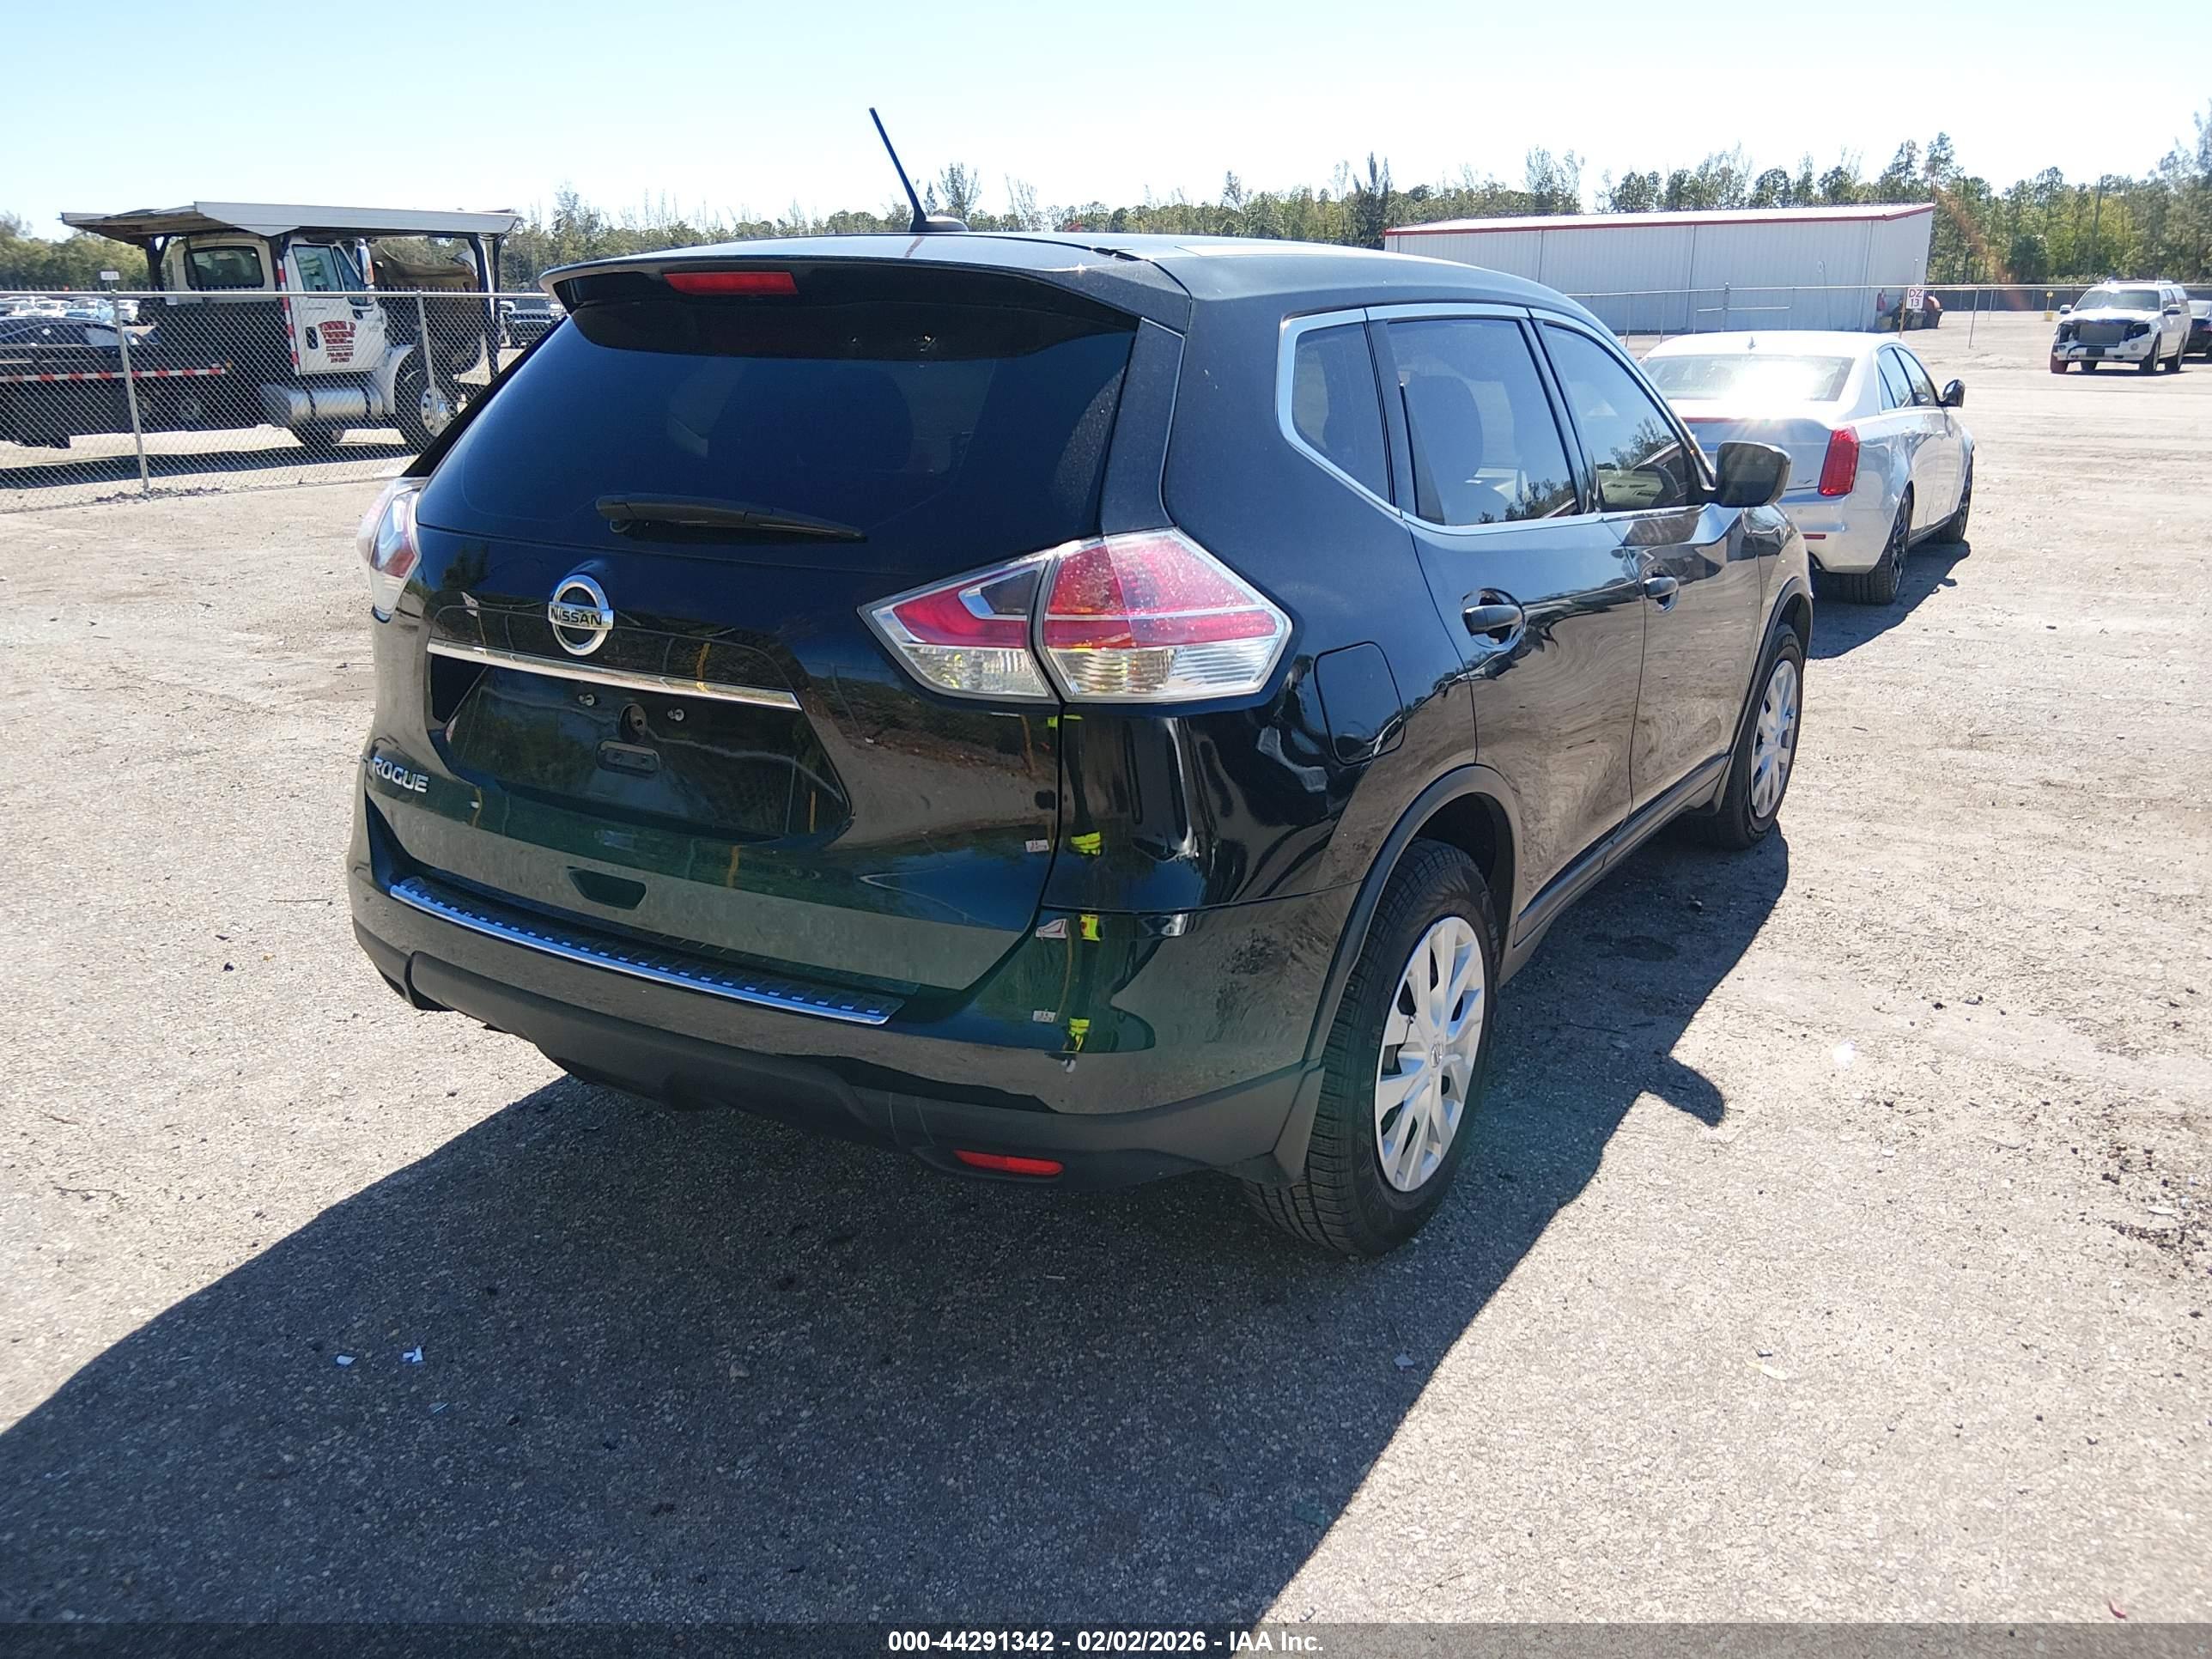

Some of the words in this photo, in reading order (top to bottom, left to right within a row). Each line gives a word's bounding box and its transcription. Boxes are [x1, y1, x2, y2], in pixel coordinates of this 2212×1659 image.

[1909, 289, 1923, 298] DZ
[1911, 298, 1919, 307] 13
[550, 607, 602, 626] NISSAN
[373, 757, 428, 793] ROGUE
